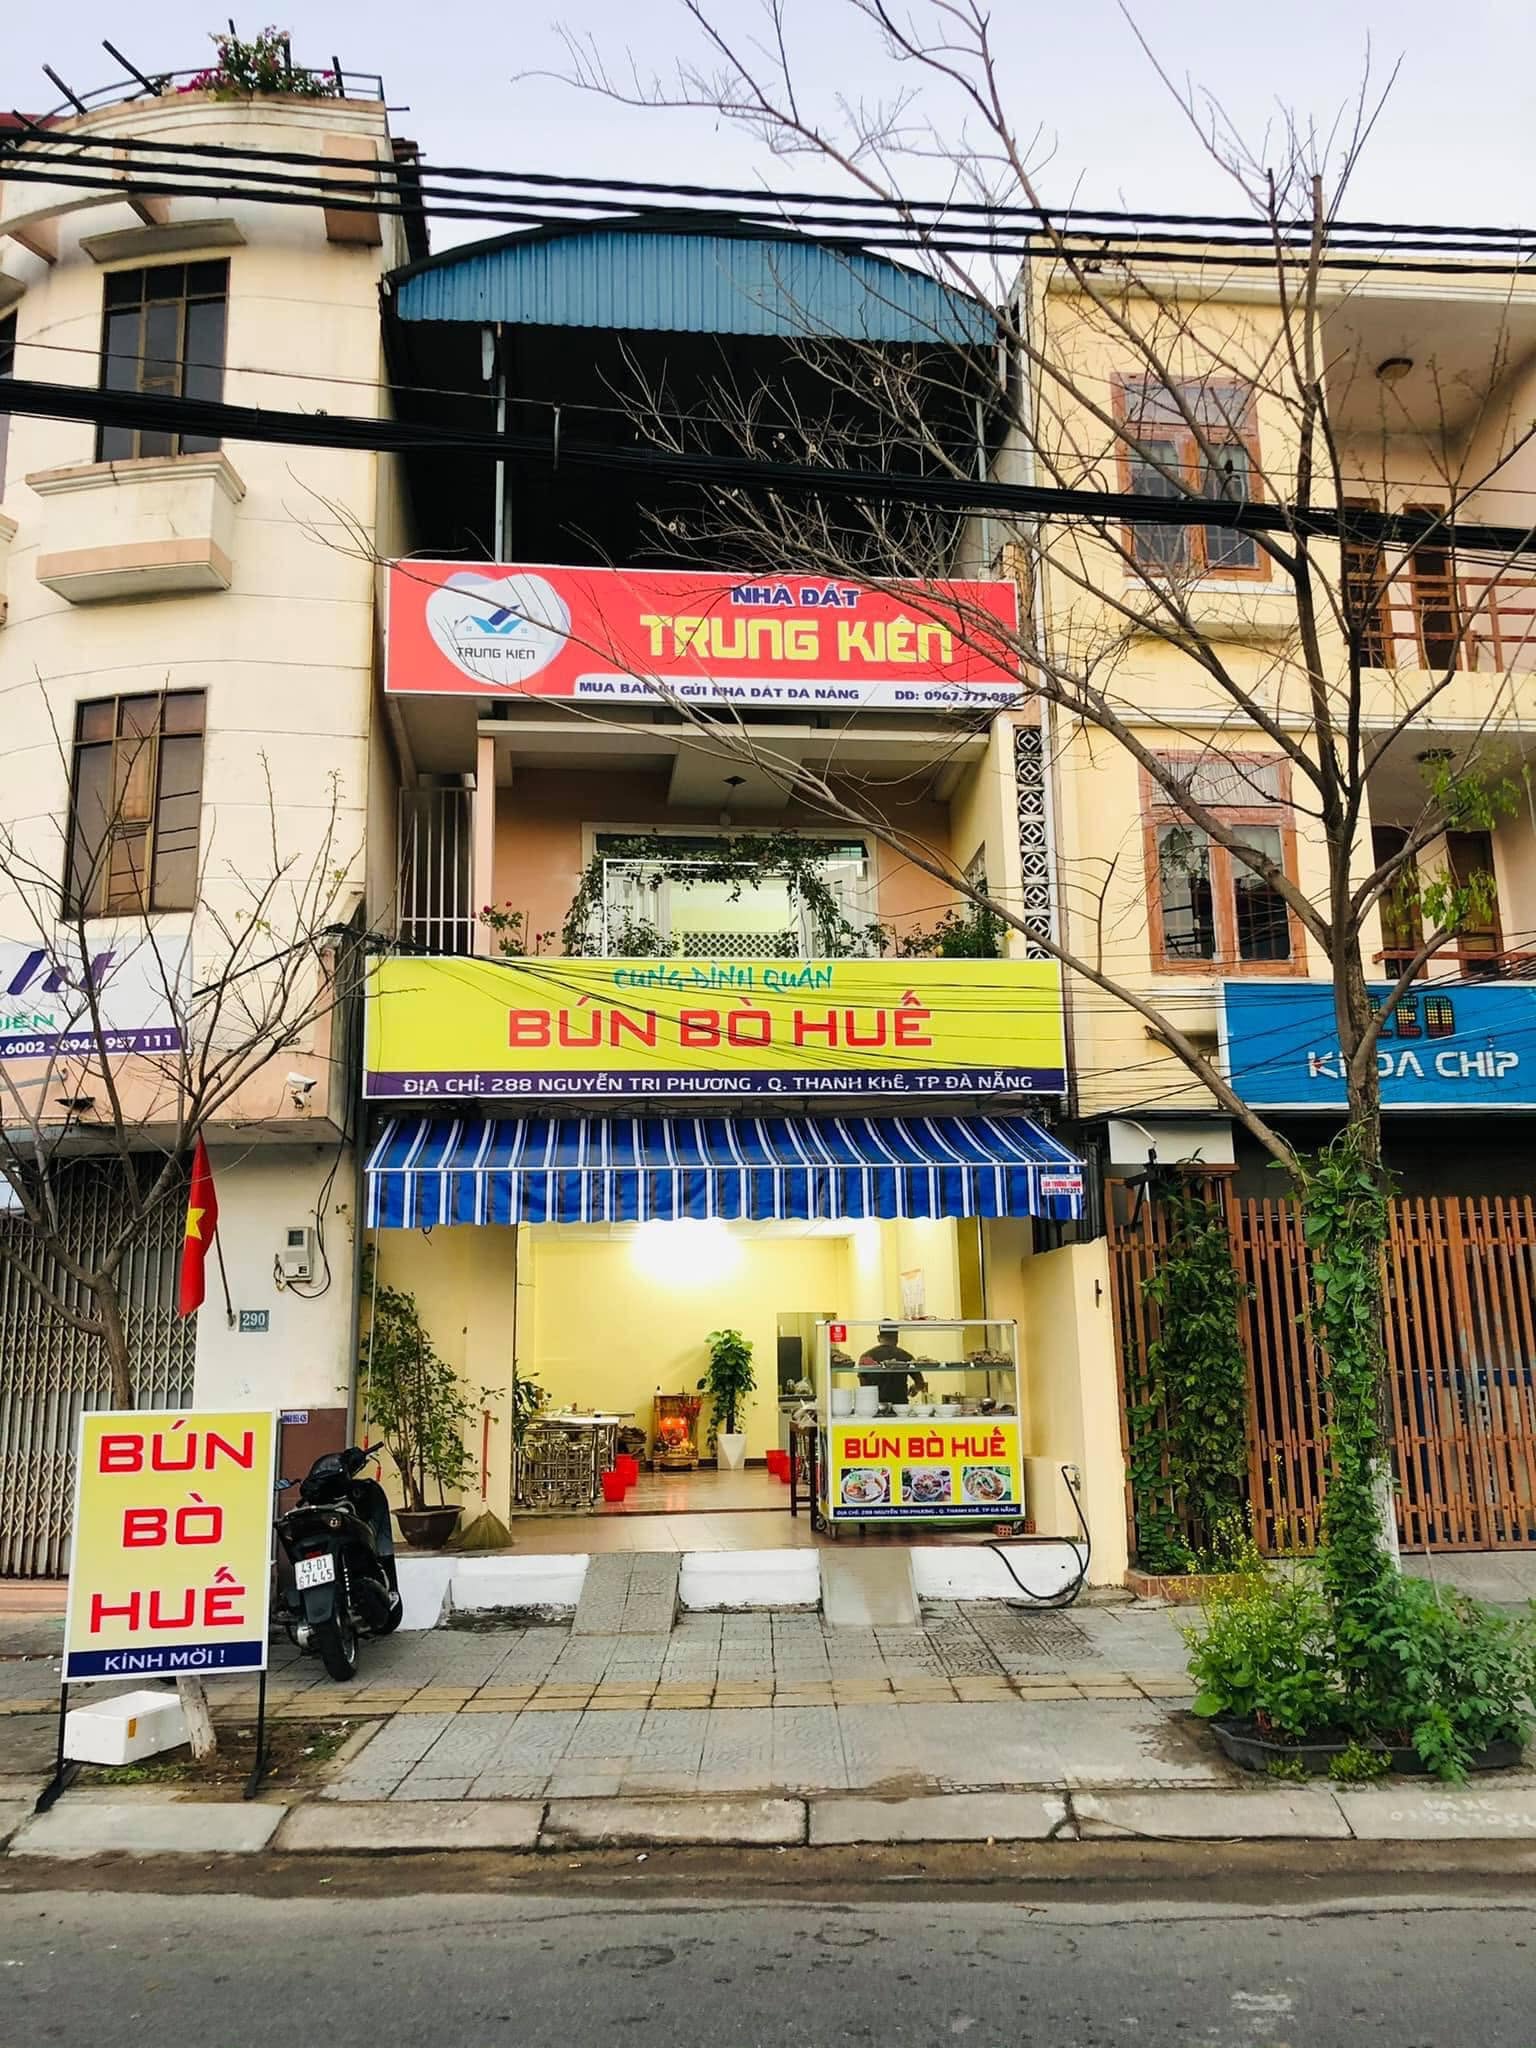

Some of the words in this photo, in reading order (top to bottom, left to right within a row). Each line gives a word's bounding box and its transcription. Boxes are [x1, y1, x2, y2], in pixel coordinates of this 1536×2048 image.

[640, 614, 819, 661] TRUNG
[838, 614, 953, 663] KIÊN
[579, 682, 615, 694] MUA
[509, 995, 657, 1048] BÚN
[679, 996, 772, 1048] BÒ
[794, 990, 932, 1047] HUẾ
[491, 1078, 532, 1092] 288
[538, 1072, 623, 1092] NGUYỄN
[629, 1077, 661, 1091] TRI
[666, 1076, 751, 1091] PHƯƠNG
[792, 1076, 862, 1090] THANH
[915, 1075, 940, 1089] TP
[242, 1312, 266, 1326] 290
[99, 1419, 254, 1473] BÚN
[844, 1431, 901, 1459] BÚN
[907, 1430, 945, 1458] BÒ
[951, 1426, 1006, 1458] HUẾ
[122, 1493, 223, 1548] BÒ
[90, 1567, 246, 1633] HUẾ
